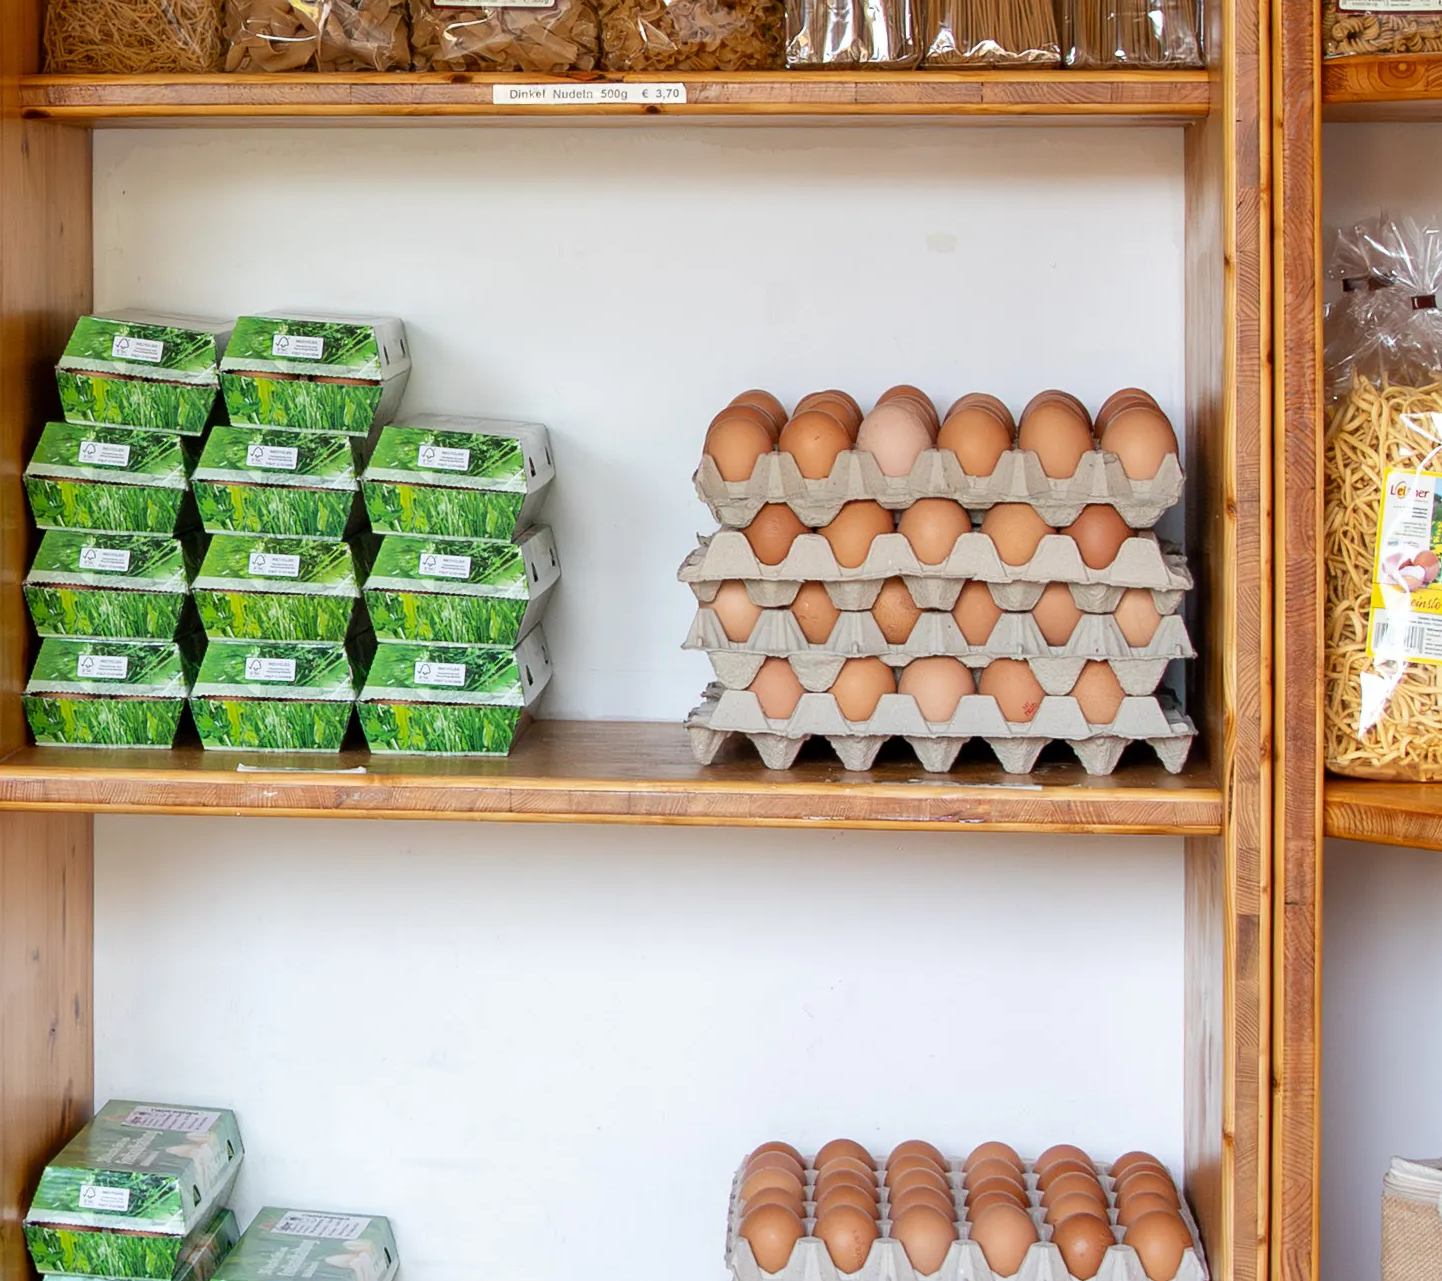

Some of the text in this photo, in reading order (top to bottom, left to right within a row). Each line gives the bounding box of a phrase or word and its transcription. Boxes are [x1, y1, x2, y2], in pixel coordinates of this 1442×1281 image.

[509, 88, 546, 100] Dinkel
[552, 89, 593, 99] Nudeln
[600, 88, 628, 100] 500g
[655, 88, 680, 99] 3,70
